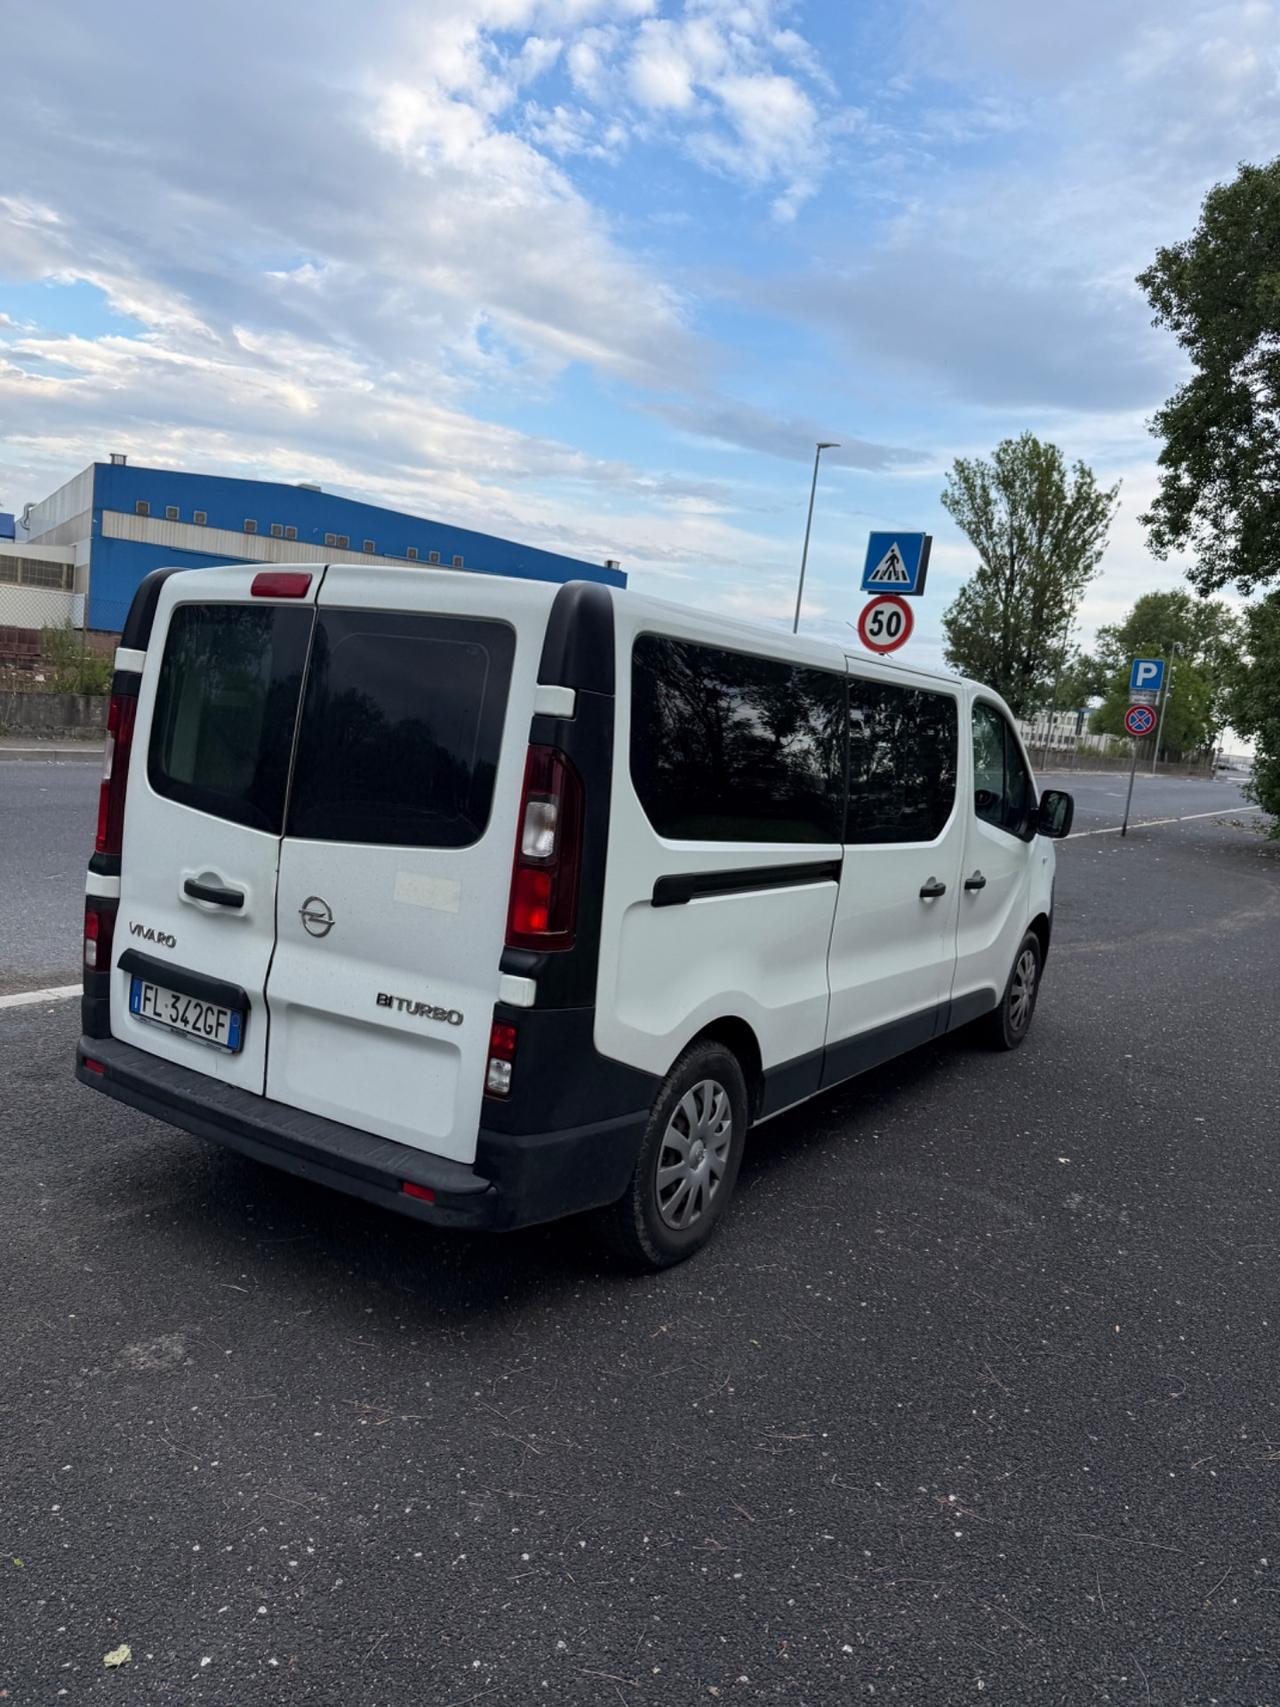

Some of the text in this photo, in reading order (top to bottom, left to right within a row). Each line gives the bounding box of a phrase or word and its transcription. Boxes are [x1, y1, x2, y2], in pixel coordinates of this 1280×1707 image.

[868, 609, 902, 638] 50
[1136, 662, 1158, 686] P
[129, 921, 177, 949] VIVARO
[142, 983, 162, 1018] FL
[169, 993, 228, 1039] 342GF
[376, 992, 464, 1026] BITURBO
